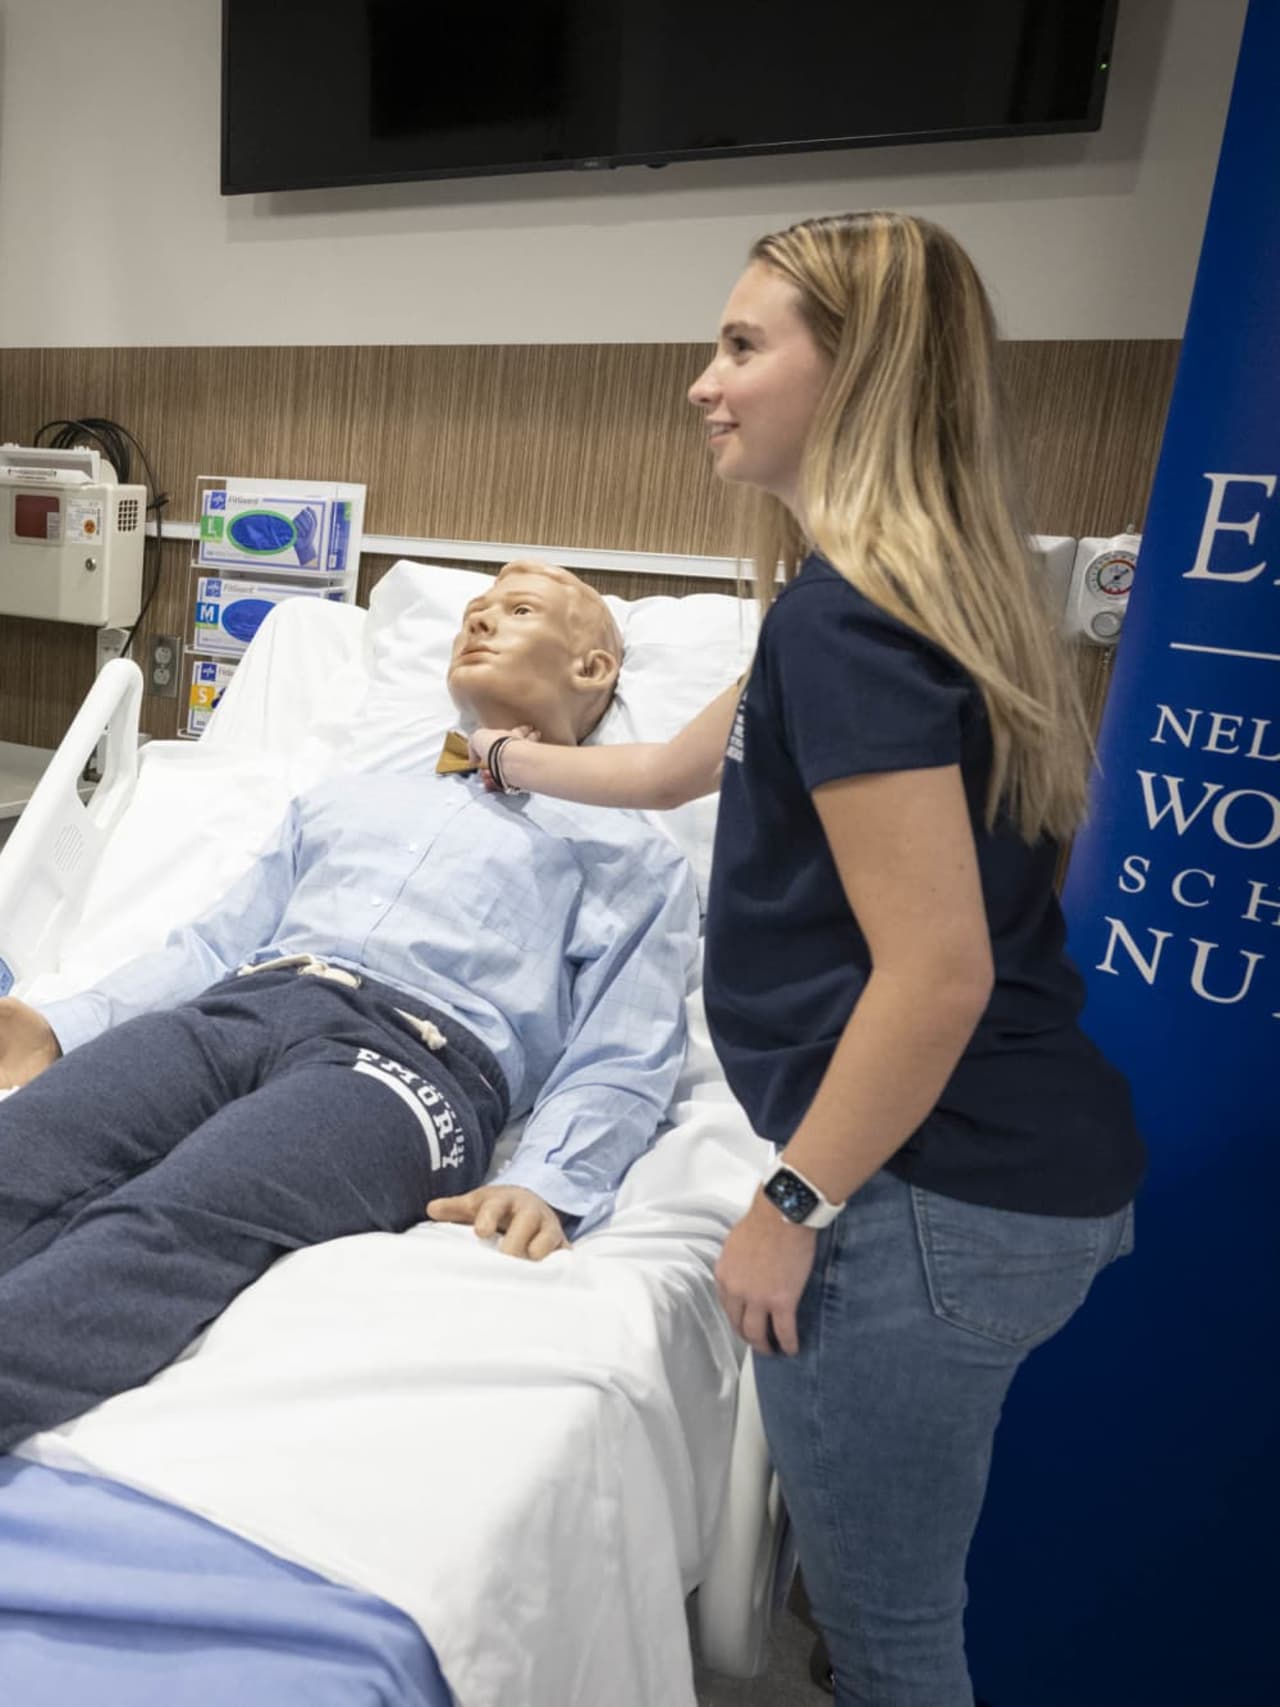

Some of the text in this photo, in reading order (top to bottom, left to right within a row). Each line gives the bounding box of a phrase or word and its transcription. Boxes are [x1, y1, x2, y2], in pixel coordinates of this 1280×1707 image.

[207, 518, 216, 535] L
[1182, 472, 1280, 585] E
[200, 606, 215, 622] M
[198, 688, 208, 704] S
[1151, 704, 1280, 761] NEL
[1137, 769, 1280, 849] WO
[1119, 855, 1280, 921] SCH
[1095, 916, 1280, 1003] NU
